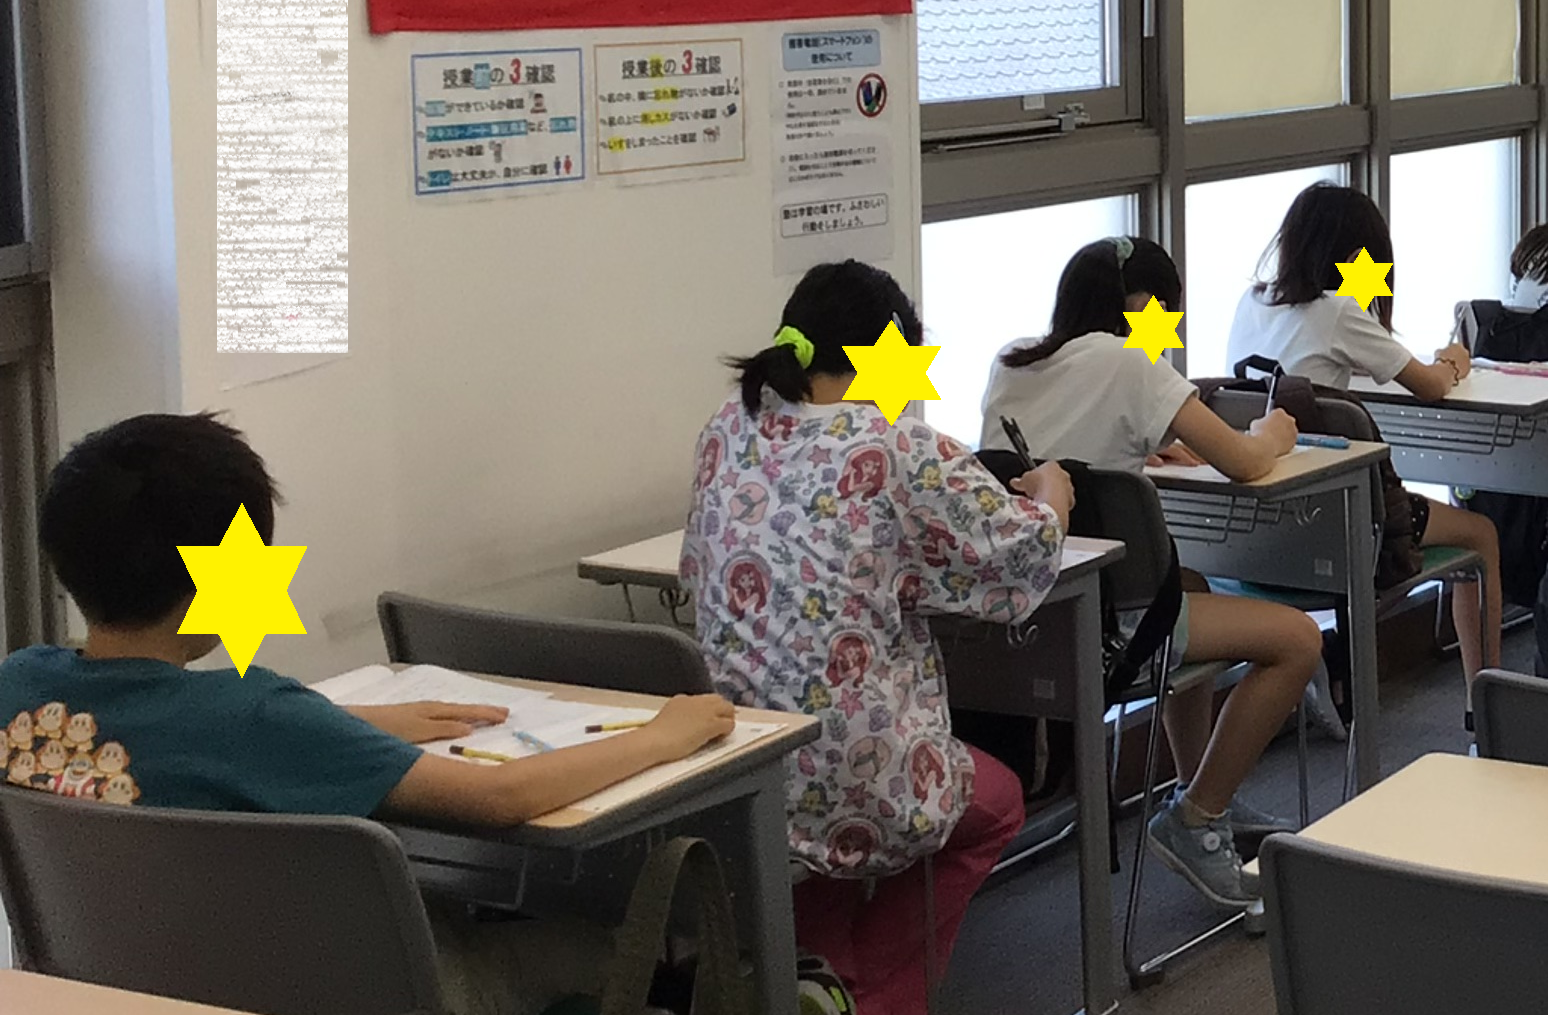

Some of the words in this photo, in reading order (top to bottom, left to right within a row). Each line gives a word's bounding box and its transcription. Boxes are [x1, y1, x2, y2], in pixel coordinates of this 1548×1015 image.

[426, 98, 525, 117] ができているか確認
